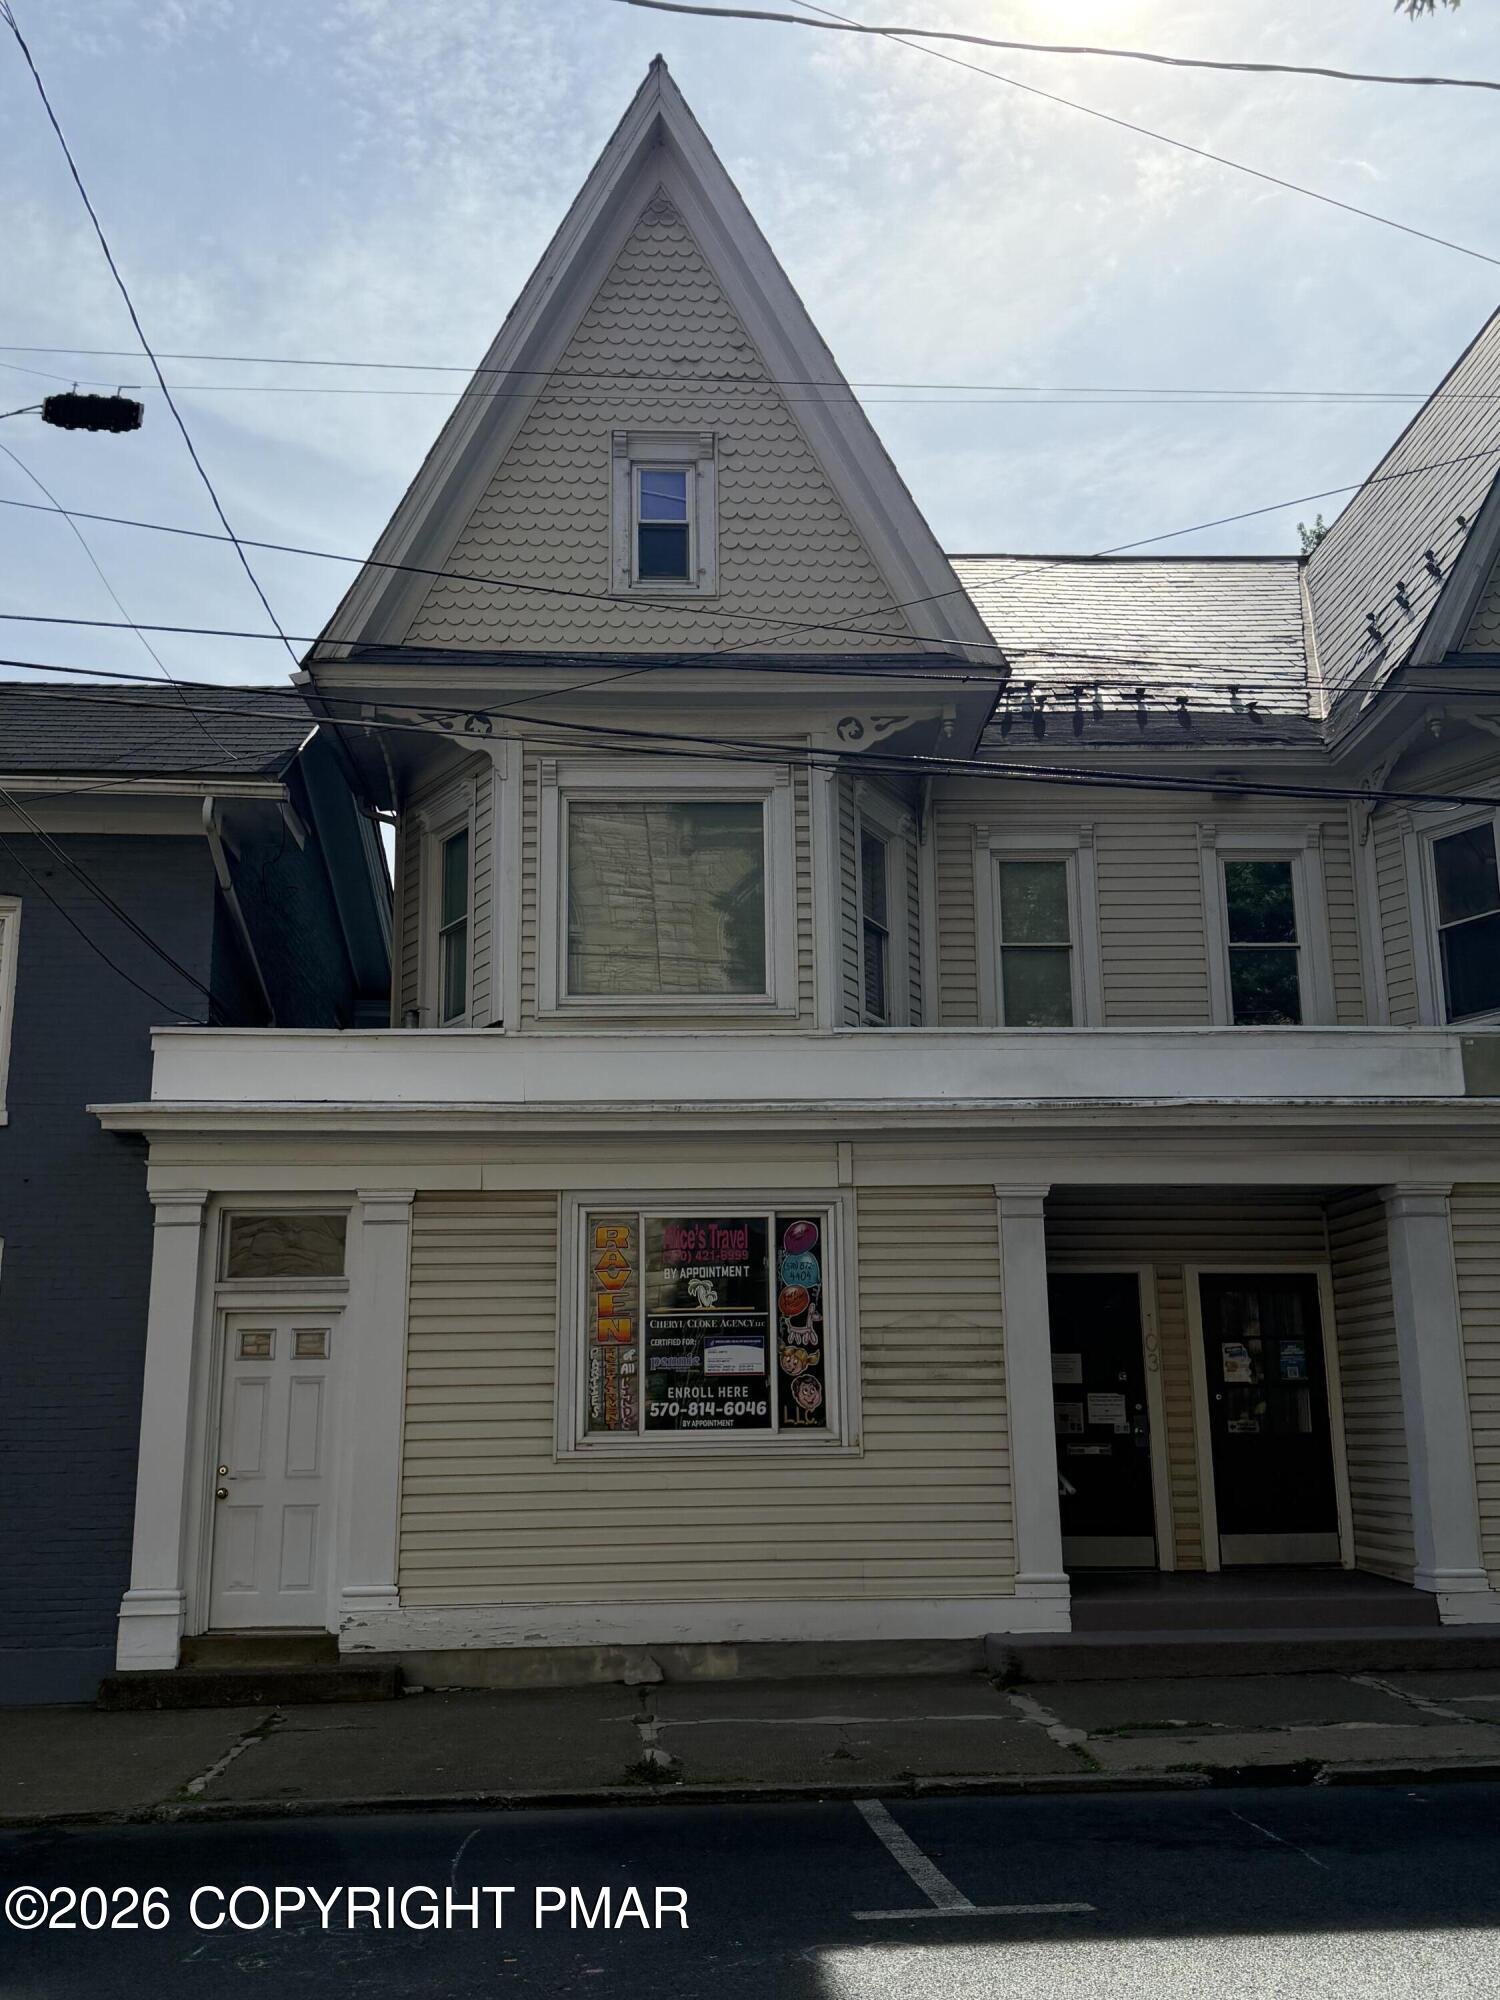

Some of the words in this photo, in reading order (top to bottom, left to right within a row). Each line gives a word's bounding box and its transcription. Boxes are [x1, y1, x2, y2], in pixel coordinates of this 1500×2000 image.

[708, 1223, 749, 1249] Travel
[663, 1267, 678, 1280] BY
[594, 1226, 632, 1343] RAVEN
[650, 1320, 684, 1329] CHERYL
[687, 1319, 717, 1328] CLOKE
[720, 1319, 755, 1328] AGENCY
[650, 1338, 681, 1347] CERTIFIED
[682, 1338, 696, 1346] FOR:
[668, 1386, 714, 1399] ENROLL
[718, 1386, 749, 1398] HERE
[649, 1401, 767, 1417] 570-814-6046
[682, 1419, 691, 1427] BY
[691, 1419, 734, 1427] APPOINTMENT
